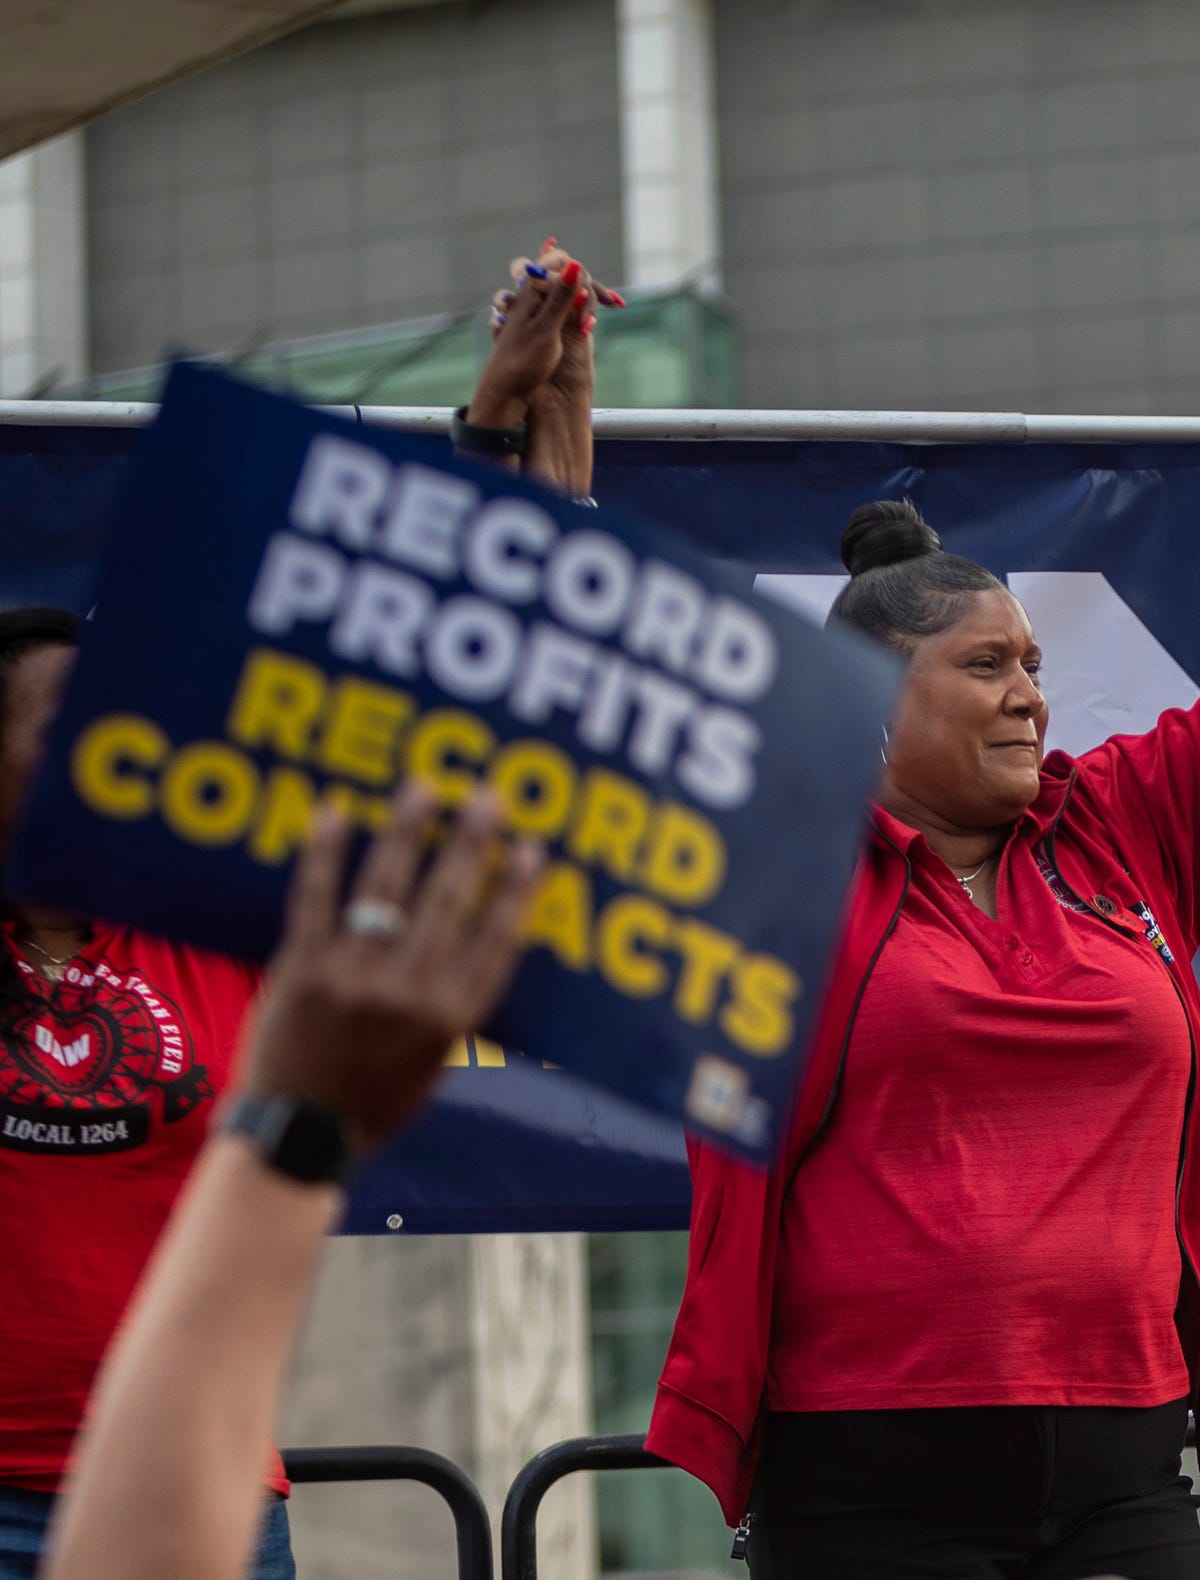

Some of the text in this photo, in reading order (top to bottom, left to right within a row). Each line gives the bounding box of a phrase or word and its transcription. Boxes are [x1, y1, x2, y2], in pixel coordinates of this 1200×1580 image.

[249, 531, 762, 808] PROFITS
[290, 433, 779, 705] RECORD
[72, 715, 802, 1059] CONACTS
[226, 648, 728, 907] RECORD
[2, 1115, 129, 1145] LOCAL 1264
[160, 1023, 184, 1074] EVER
